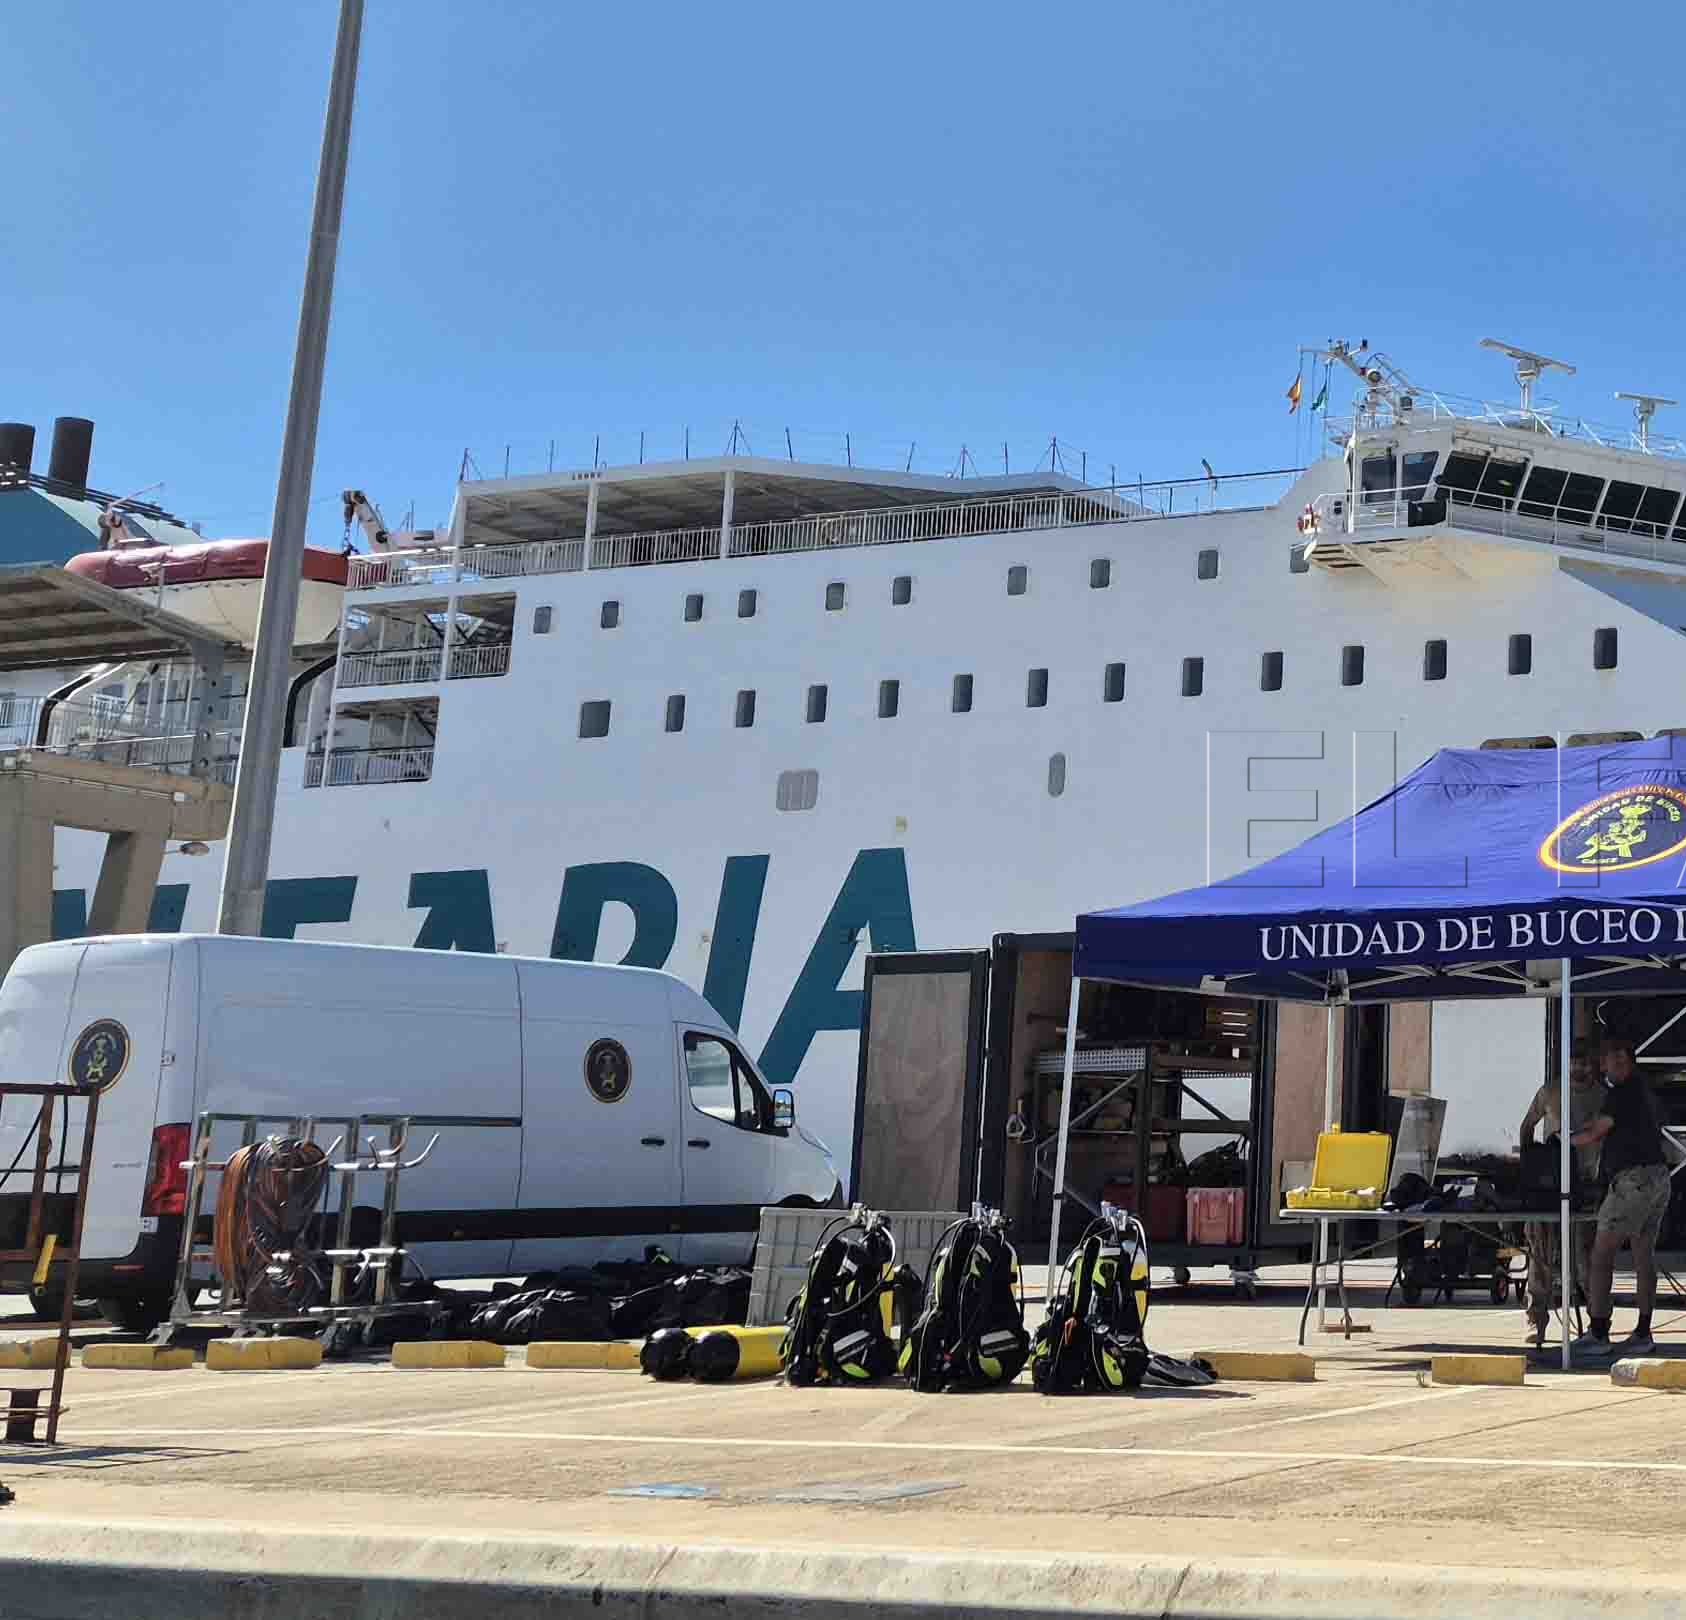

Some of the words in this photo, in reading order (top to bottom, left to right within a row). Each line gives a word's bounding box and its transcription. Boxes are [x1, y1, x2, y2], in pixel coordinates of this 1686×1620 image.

[1259, 920, 1425, 961] UNIDAD
[1435, 915, 1496, 952] DE
[1506, 907, 1661, 949] BUCEO
